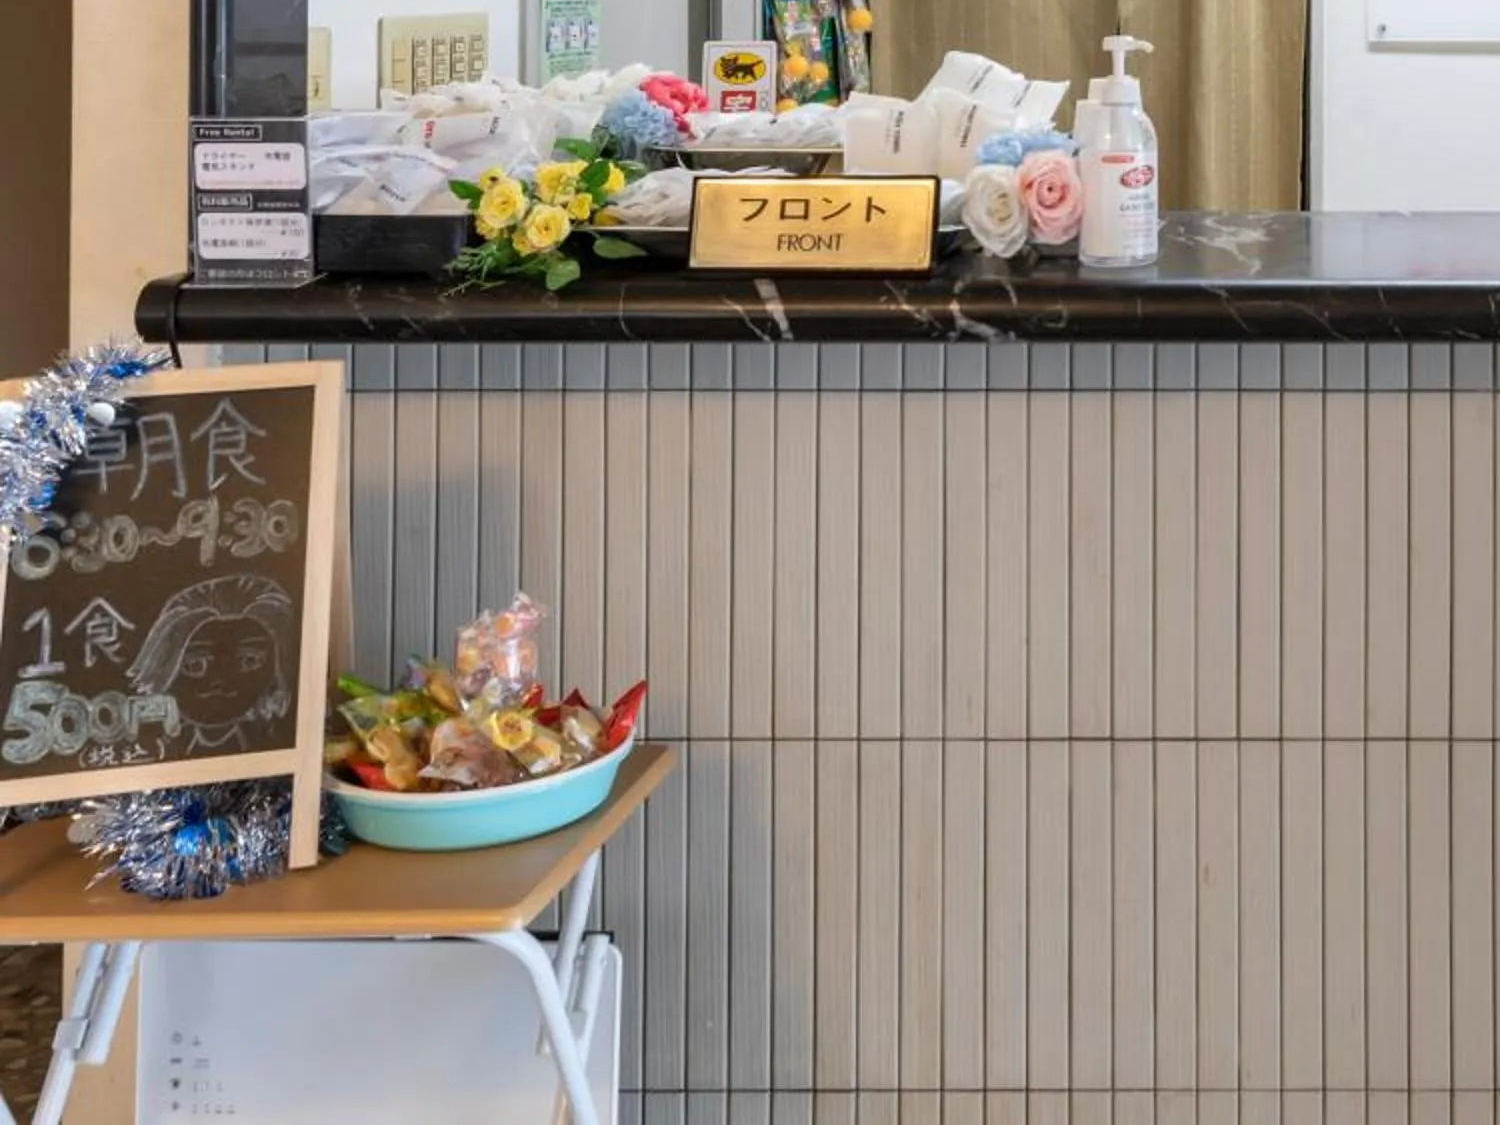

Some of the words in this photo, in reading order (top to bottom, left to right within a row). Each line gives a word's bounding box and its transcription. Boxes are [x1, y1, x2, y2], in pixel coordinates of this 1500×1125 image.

[739, 196, 886, 223] フロント
[776, 233, 844, 252] FRONT
[72, 397, 267, 501] 朝食
[18, 596, 136, 679] 1食
[1, 679, 182, 765] 500円
